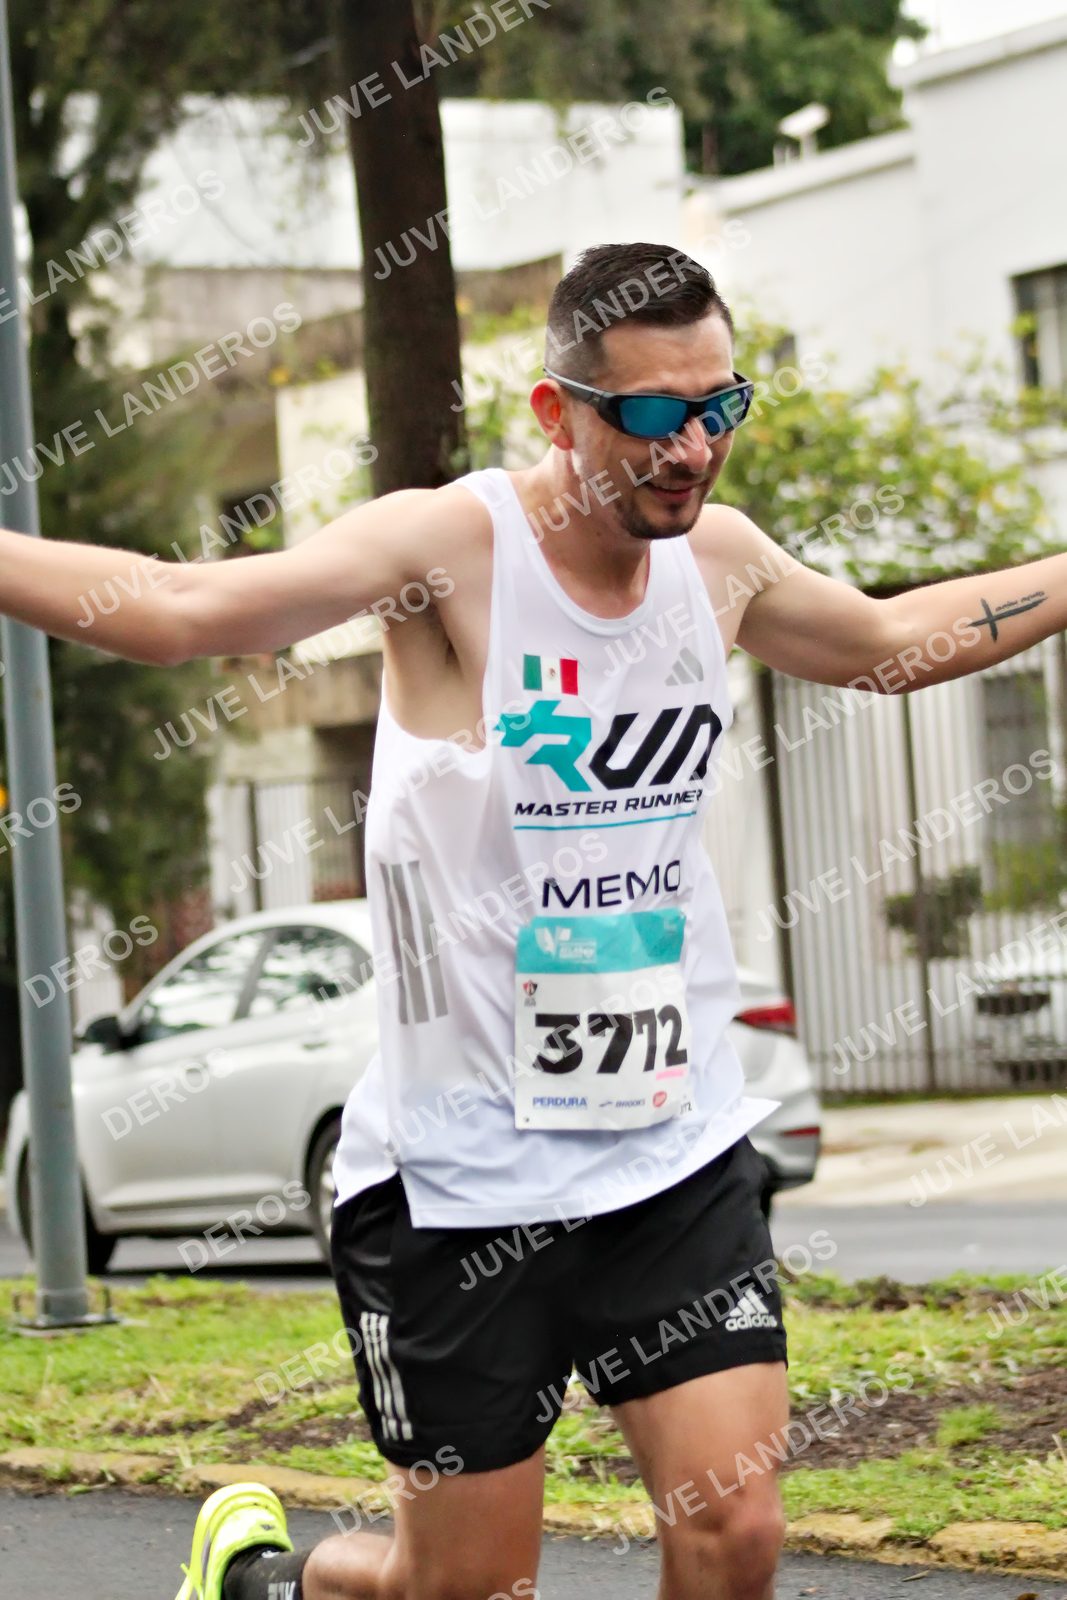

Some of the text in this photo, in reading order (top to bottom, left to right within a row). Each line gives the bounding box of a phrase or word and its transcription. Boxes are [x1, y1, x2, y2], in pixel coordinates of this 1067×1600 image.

[514, 801, 617, 817] MASTER
[541, 860, 681, 909] MEMO
[532, 1004, 688, 1075] 3772
[532, 1096, 588, 1108] PERDURA
[725, 1314, 777, 1332] adidas
